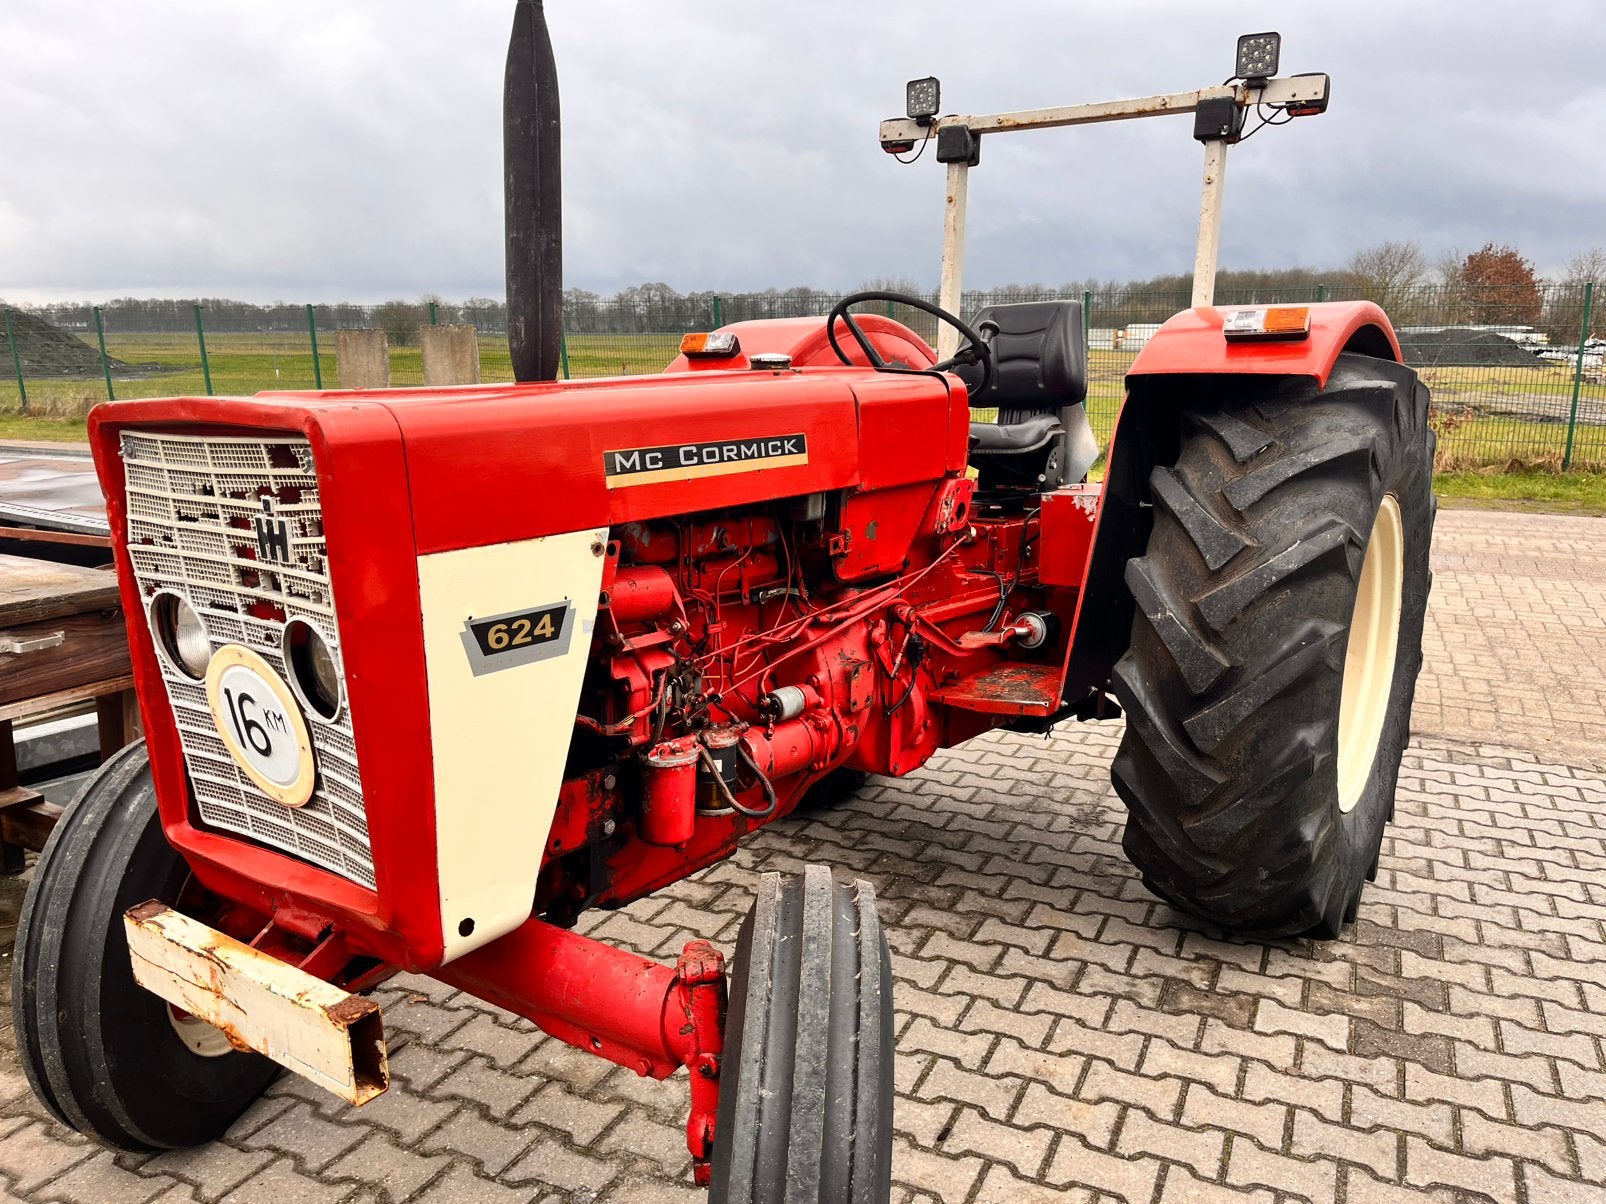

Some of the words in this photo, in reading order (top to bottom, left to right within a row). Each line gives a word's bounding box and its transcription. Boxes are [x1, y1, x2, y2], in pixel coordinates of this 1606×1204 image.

[679, 438, 799, 466] CORMICK
[487, 613, 555, 650] 624
[223, 687, 272, 757] 16
[262, 707, 289, 736] KM
